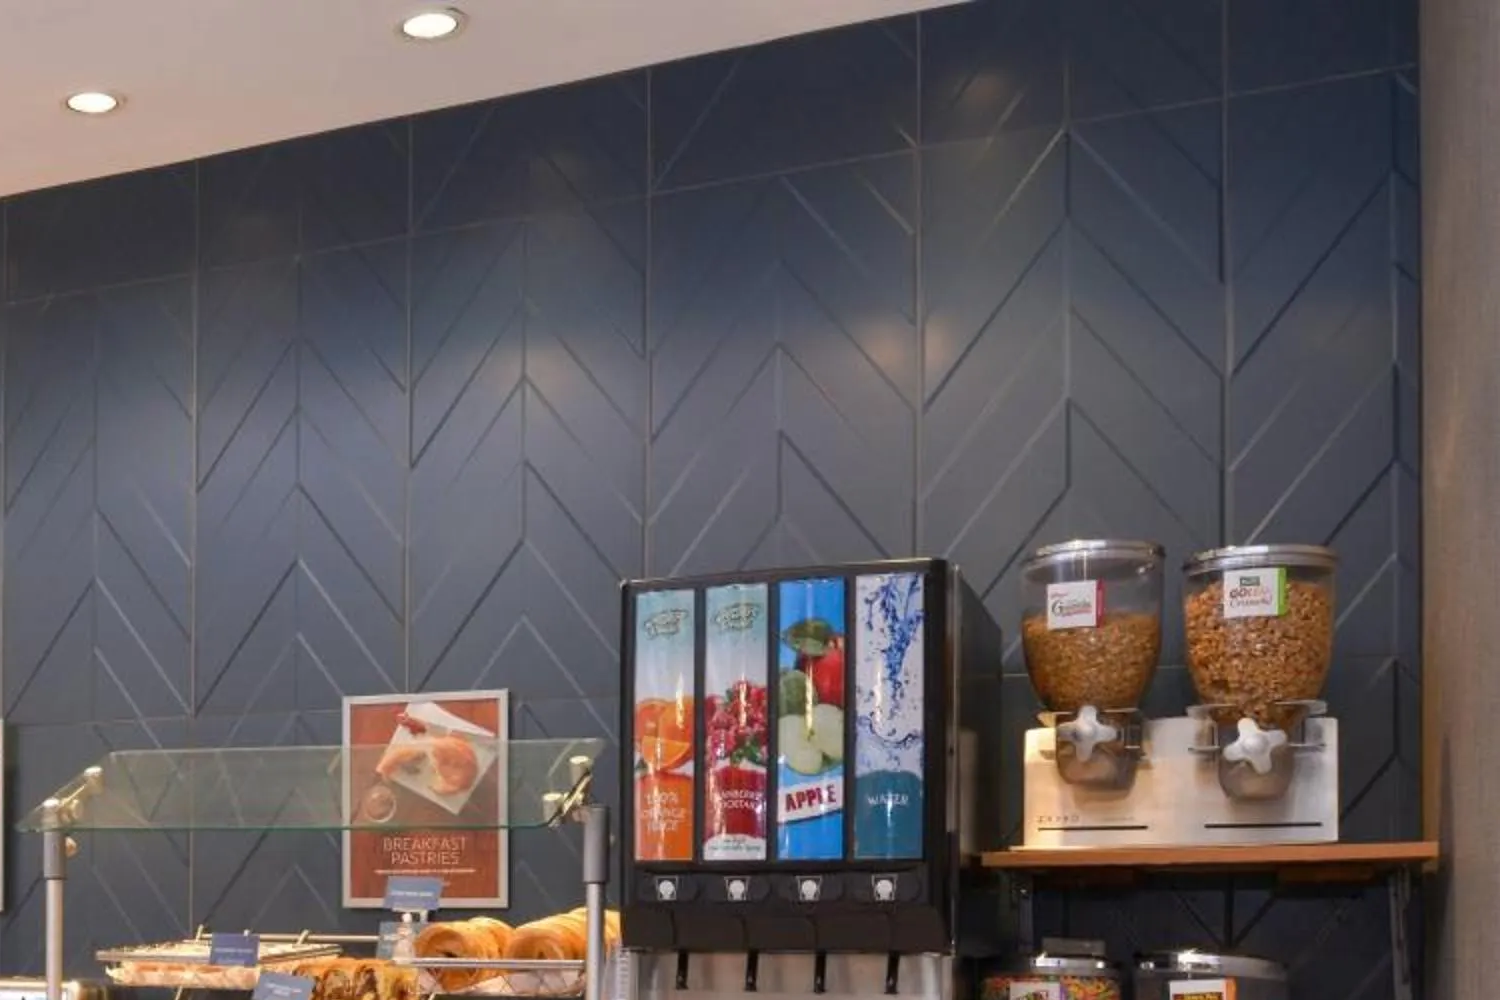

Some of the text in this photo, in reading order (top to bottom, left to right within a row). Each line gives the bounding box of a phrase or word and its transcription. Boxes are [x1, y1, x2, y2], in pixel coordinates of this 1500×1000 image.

[785, 784, 837, 812] APPLE
[867, 794, 909, 806] WATER
[382, 836, 466, 850] BREAKFAST
[391, 851, 460, 865] PASTRIES
